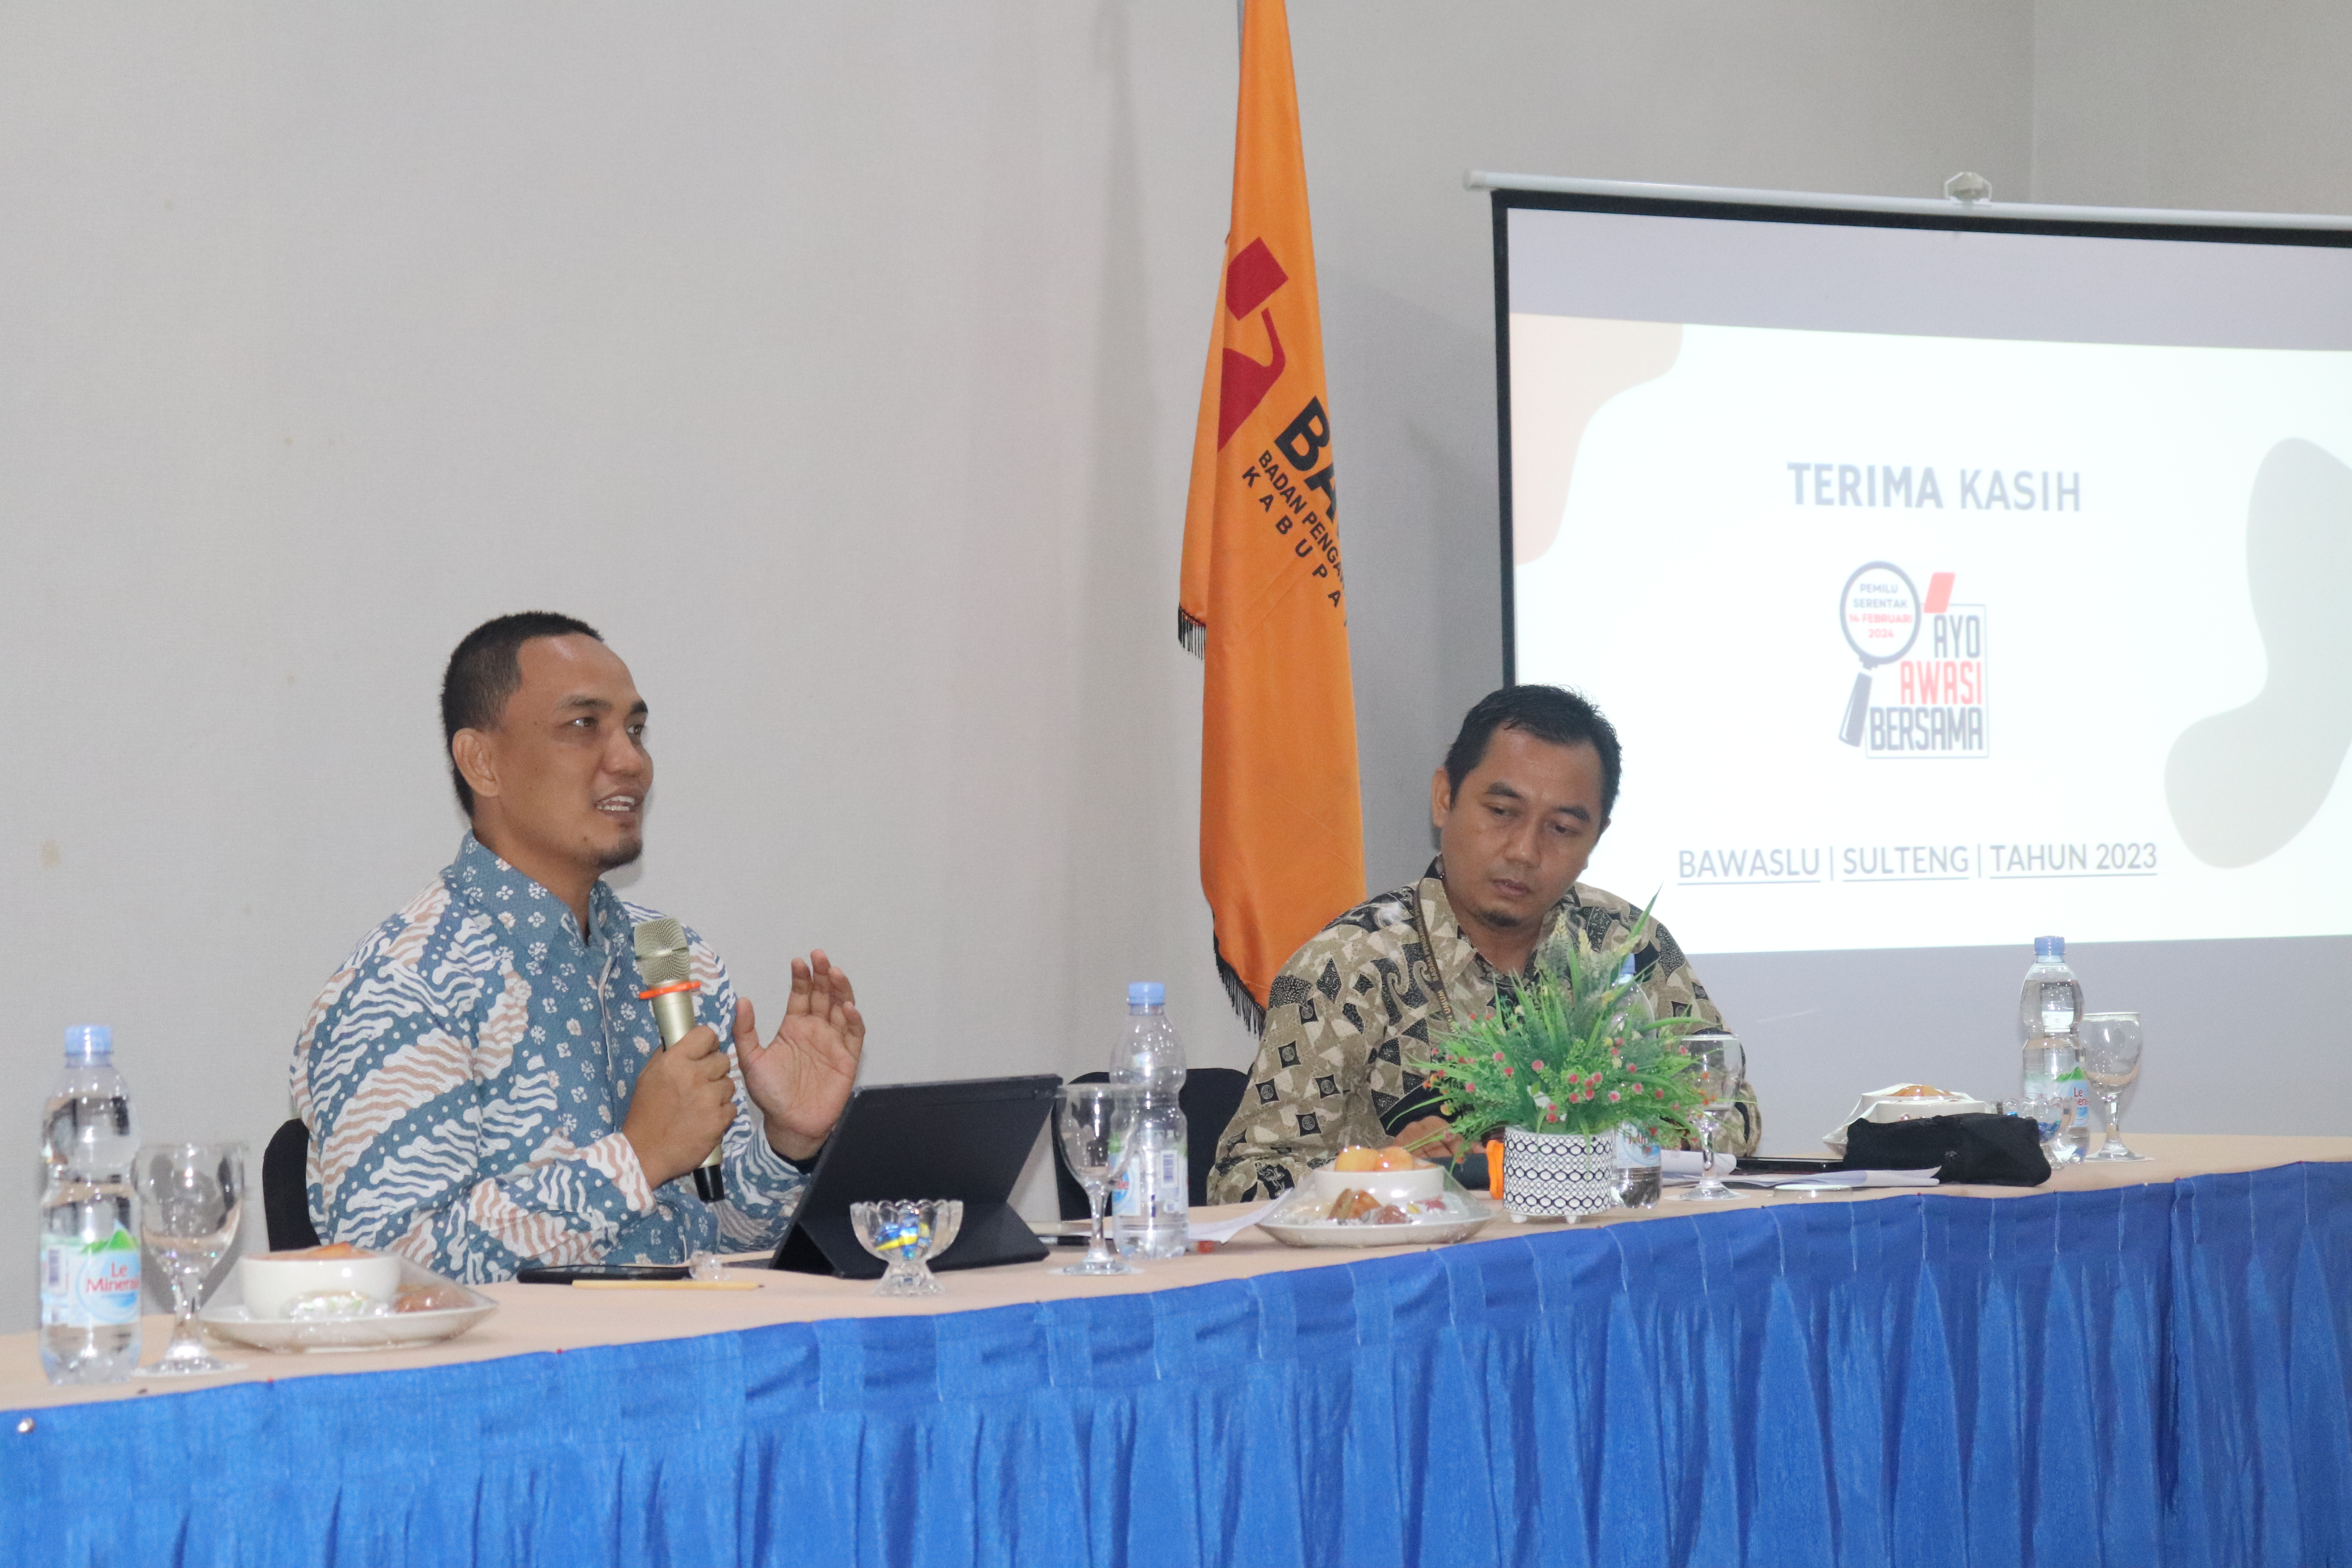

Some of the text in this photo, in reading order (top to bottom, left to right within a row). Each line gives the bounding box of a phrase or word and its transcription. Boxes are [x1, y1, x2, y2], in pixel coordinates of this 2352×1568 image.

[1274, 395, 1338, 524] BA
[1258, 449, 1307, 515] BADAN
[1787, 461, 2081, 512] TERIMA KASIH
[1241, 465, 1345, 615] KABUPA
[1853, 598, 1907, 608] SERENTAK
[1860, 583, 1898, 593] PEMILU
[1849, 613, 1913, 624] 14 FEBRUARI
[1868, 628, 1895, 639] 2024
[1933, 614, 1981, 659] AYO
[1900, 661, 1982, 705] AWASI
[1870, 706, 1983, 751] BERSAMA
[1679, 842, 2158, 878] BAWASLU SULTENG TAHUN 2023
[2074, 1087, 2083, 1097] Le
[111, 1261, 128, 1278] Le
